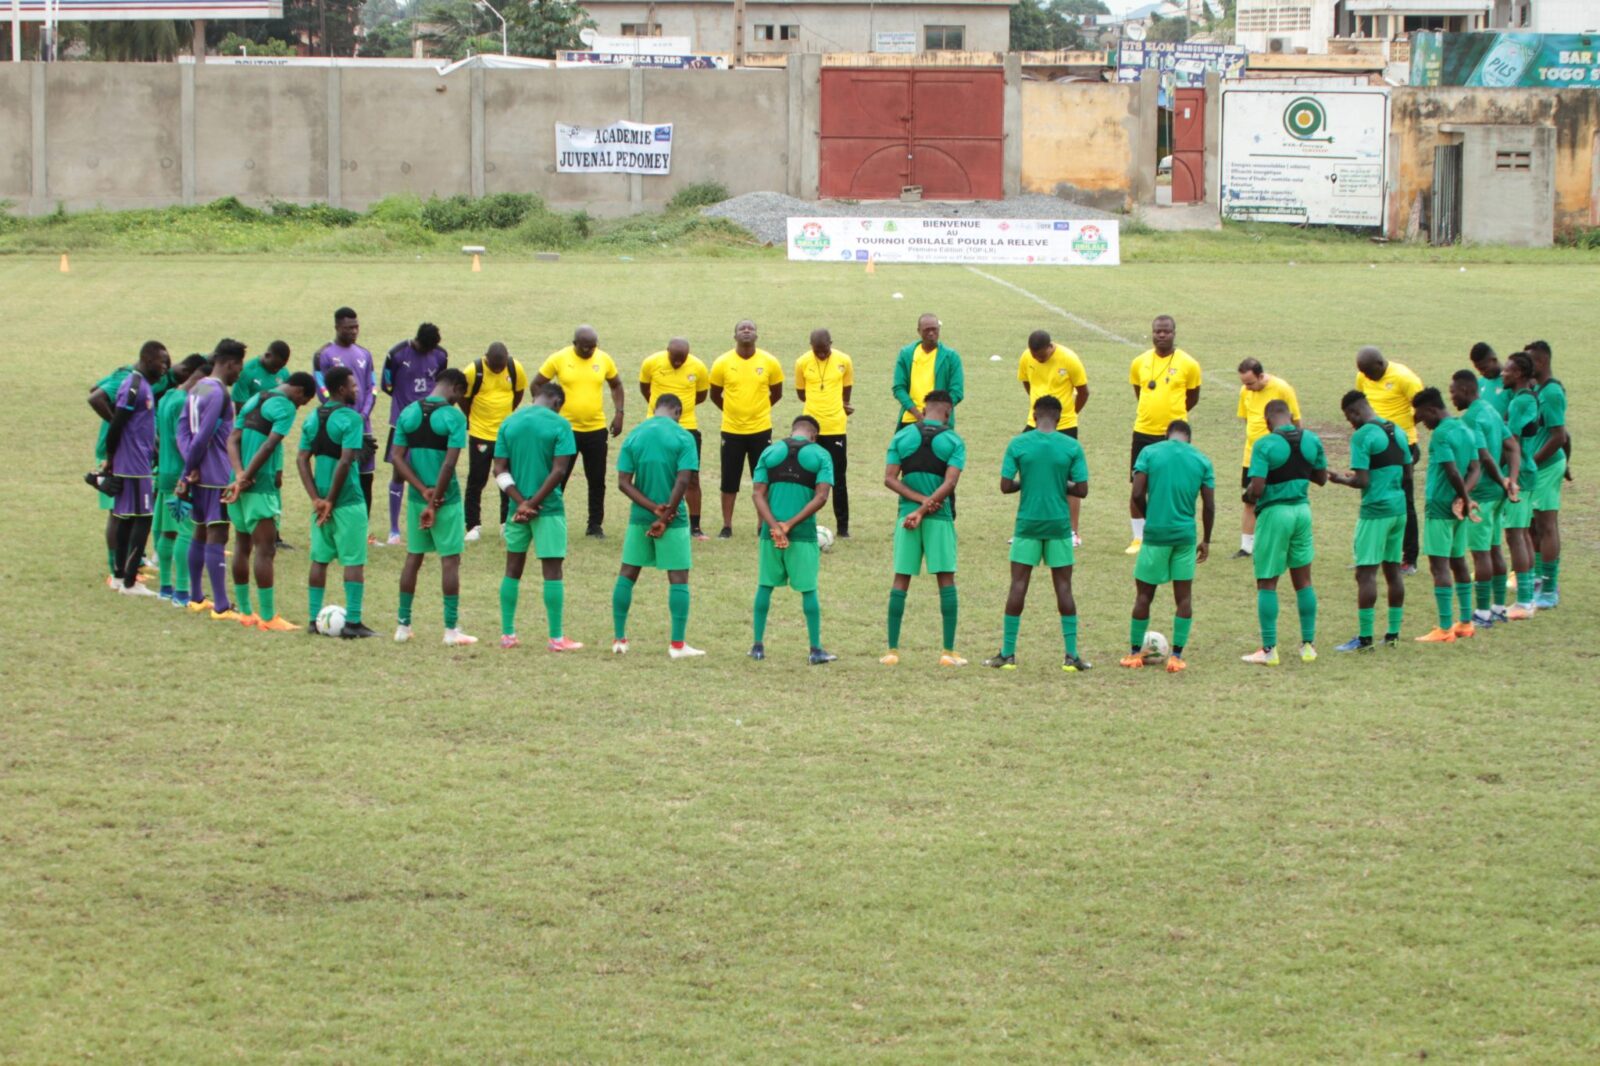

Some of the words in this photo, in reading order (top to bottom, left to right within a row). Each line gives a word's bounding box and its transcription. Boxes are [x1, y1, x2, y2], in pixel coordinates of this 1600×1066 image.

[1145, 42, 1175, 52] ELOM
[654, 55, 682, 64] STARS
[1559, 51, 1592, 64] BAR
[1488, 57, 1517, 78] PILS
[1538, 67, 1585, 80] TOGO
[595, 128, 651, 145] ACADEMIE
[559, 151, 613, 168] JUVENAL
[616, 151, 669, 169] PEDOMEY
[922, 219, 981, 228] BIENVENUE
[856, 237, 905, 245] TOURNOI
[908, 237, 954, 245] OBILALE
[957, 238, 987, 246] POUR
[990, 238, 1004, 246] LA
[414, 378, 426, 392] 23
